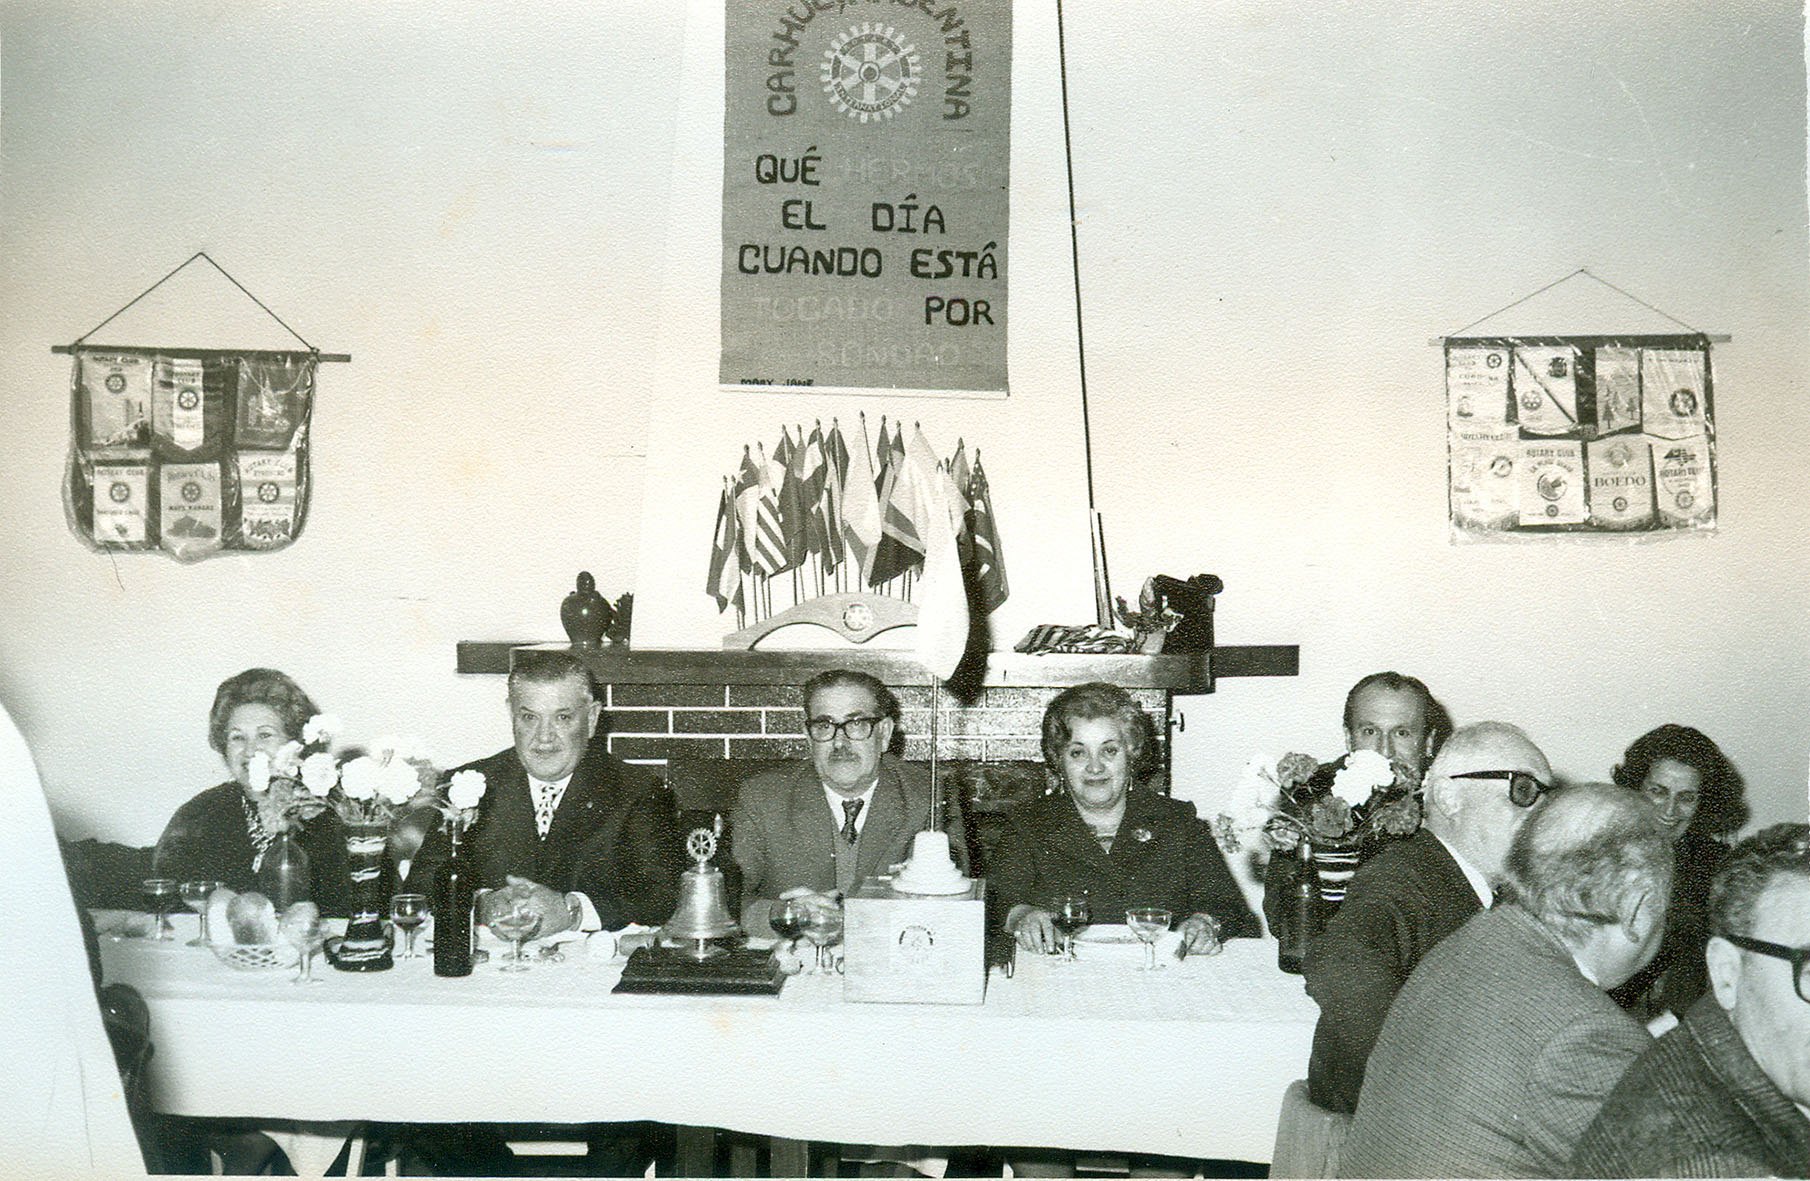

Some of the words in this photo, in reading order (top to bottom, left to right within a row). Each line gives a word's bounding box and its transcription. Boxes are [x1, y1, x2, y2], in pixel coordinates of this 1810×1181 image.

[755, 145, 822, 186] QUÉ
[782, 199, 827, 231] EL
[871, 193, 946, 234] DÍA
[738, 244, 883, 278] CUANDO
[909, 241, 998, 280] ESTÁ
[924, 295, 995, 327] POR
[1593, 475, 1647, 488] BOEDO
